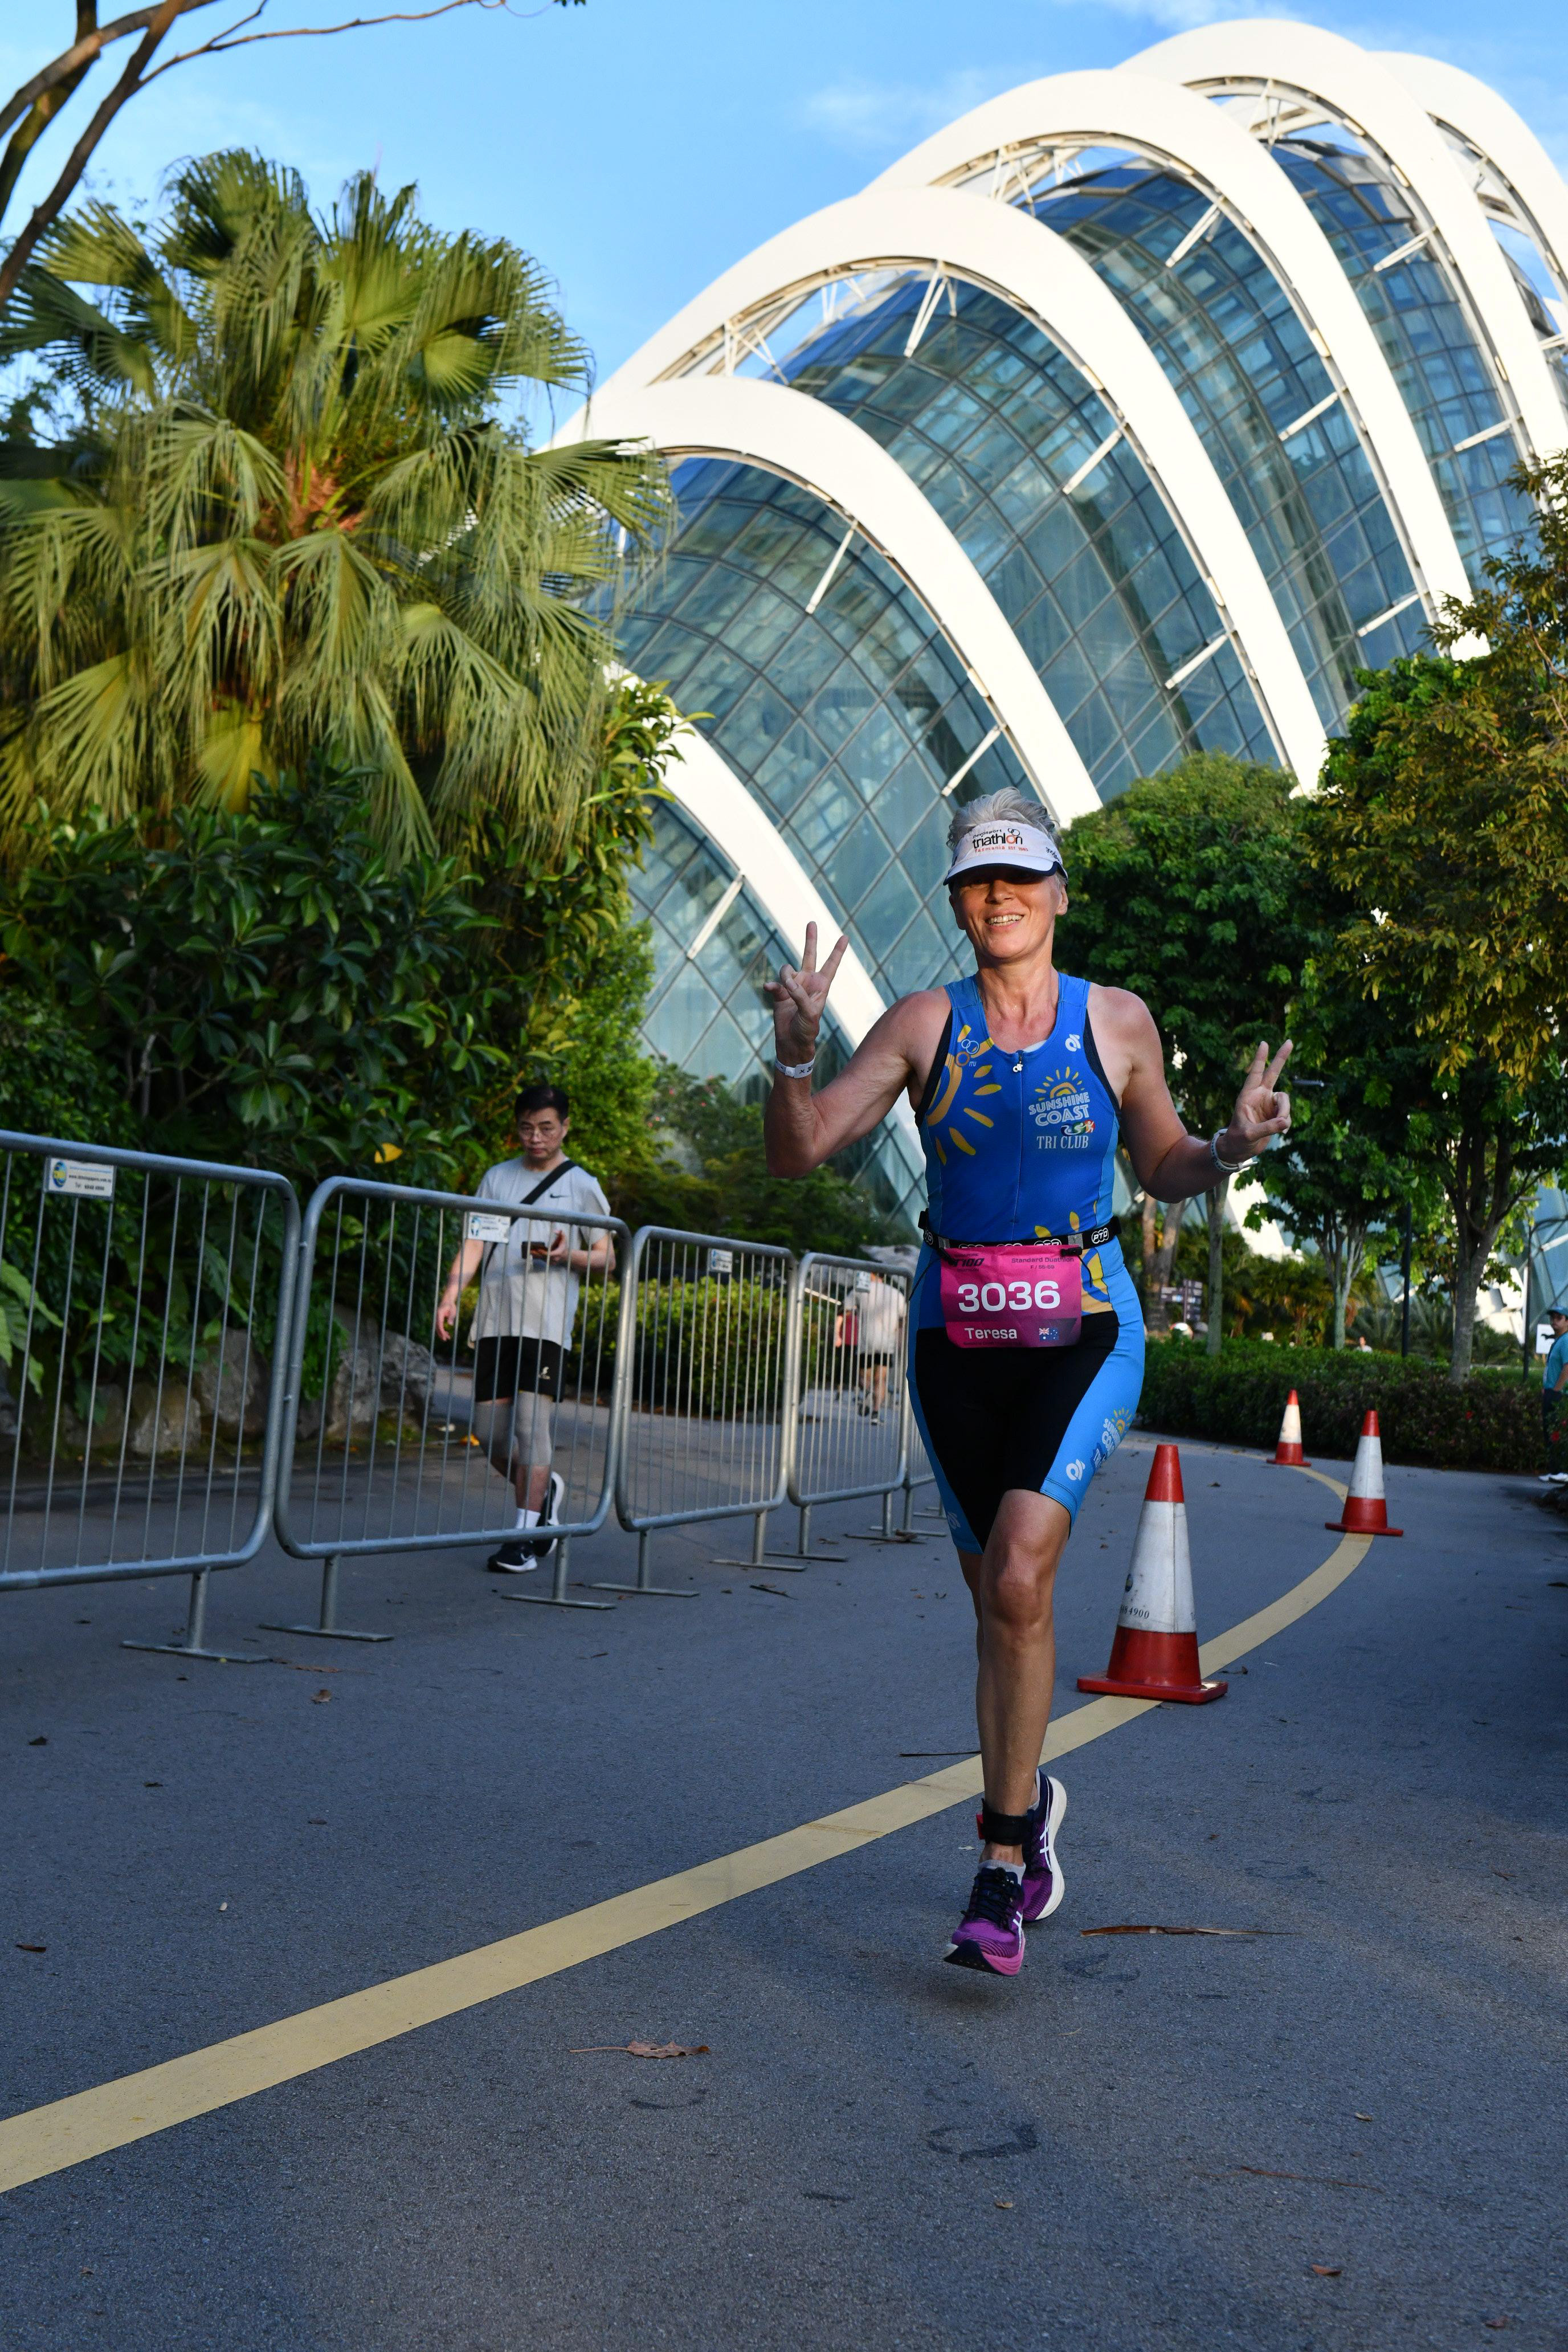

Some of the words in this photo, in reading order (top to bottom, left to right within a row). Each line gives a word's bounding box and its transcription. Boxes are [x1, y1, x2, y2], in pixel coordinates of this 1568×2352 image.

[972, 833, 1023, 848] triathlon
[1028, 1092, 1091, 1116] SUNSHINE
[1035, 1105, 1090, 1127] COAST
[1036, 1136, 1056, 1149] TRI
[1060, 1135, 1089, 1149] CLUB
[957, 1280, 1061, 1313] 3036
[964, 1328, 1018, 1340] Teresa
